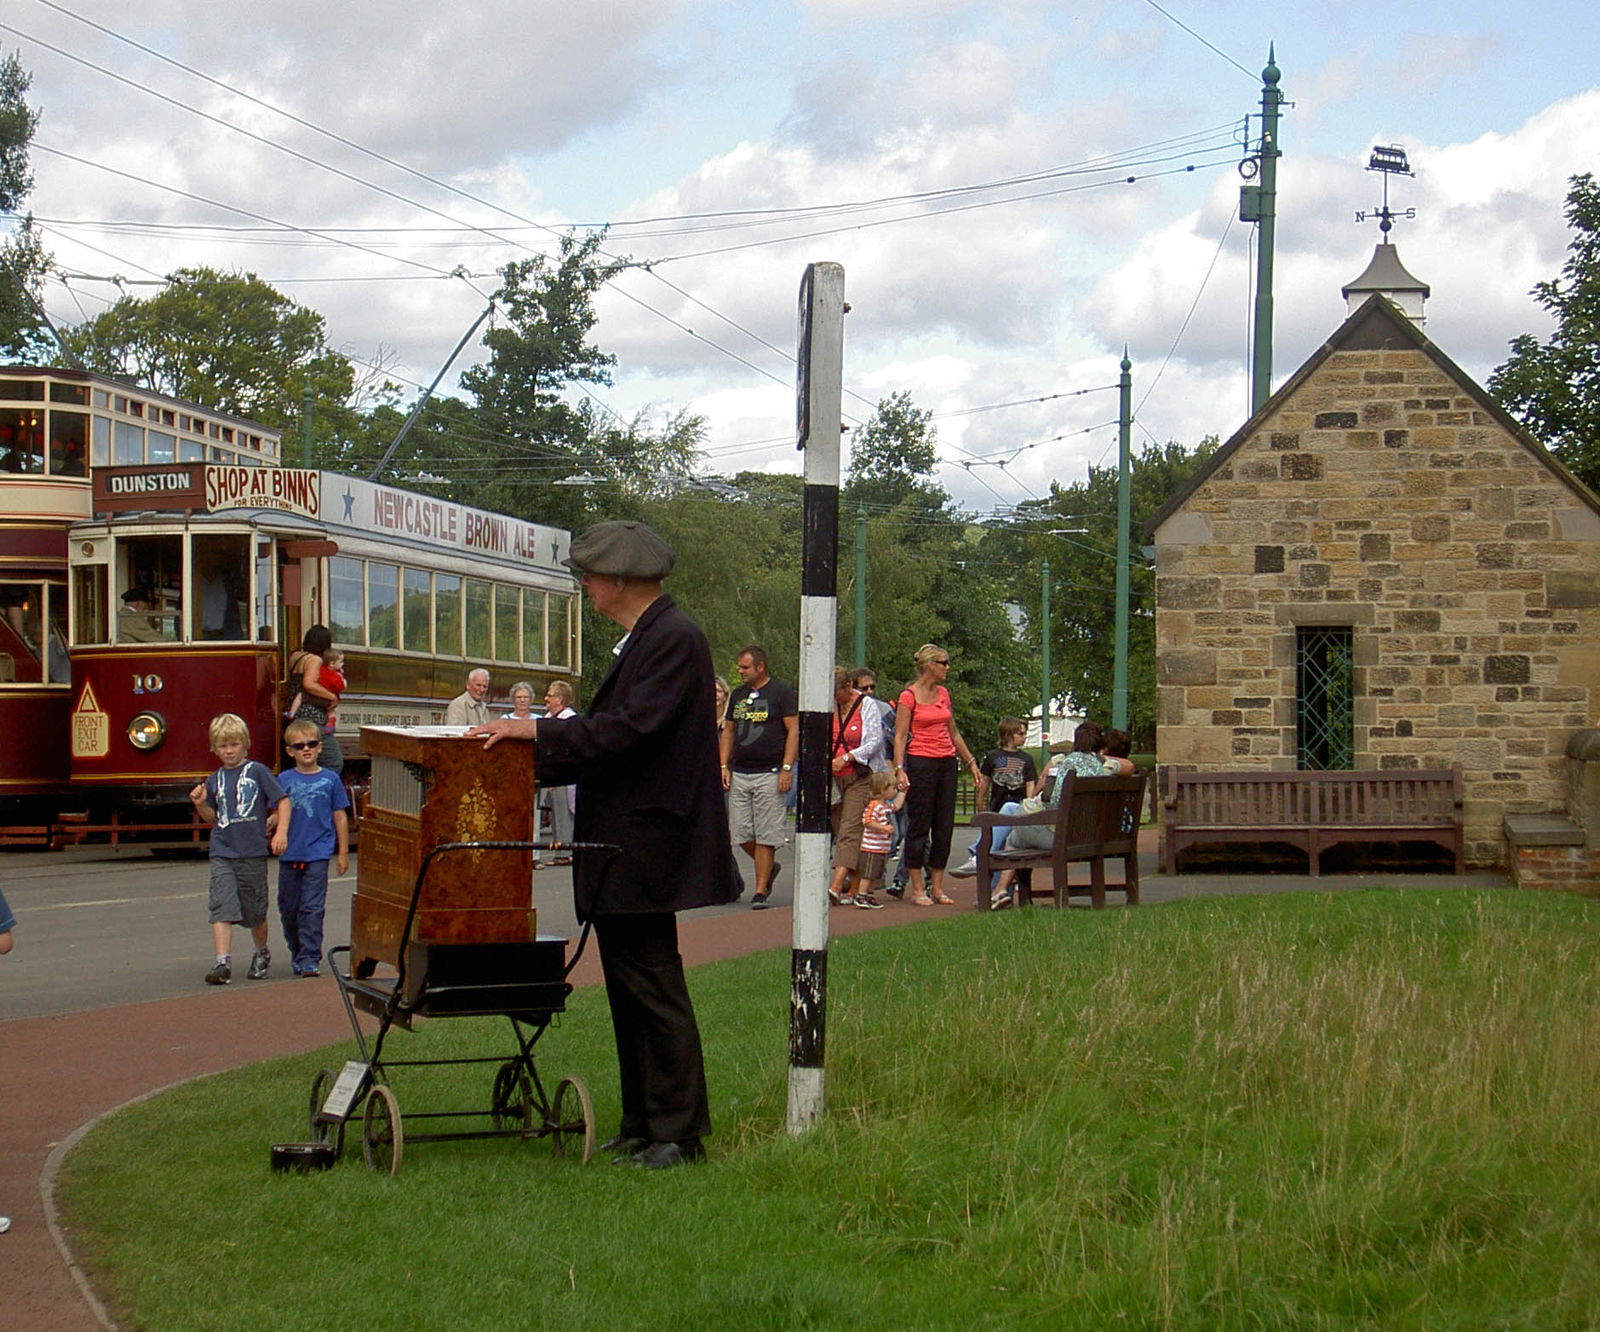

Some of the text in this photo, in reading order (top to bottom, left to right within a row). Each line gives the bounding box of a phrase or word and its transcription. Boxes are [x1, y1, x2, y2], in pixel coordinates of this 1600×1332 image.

[1406, 208, 1415, 218] S
[112, 472, 190, 493] DUNSTON
[207, 466, 318, 515] SHOP AT BINNS
[234, 496, 293, 511] FOR EVERYTHING
[374, 489, 535, 560] NEWCASTLE BROWN ALE
[132, 674, 163, 694] 10
[75, 715, 104, 728] FRONT
[78, 728, 97, 740] EXIT
[78, 740, 98, 752] CAR
